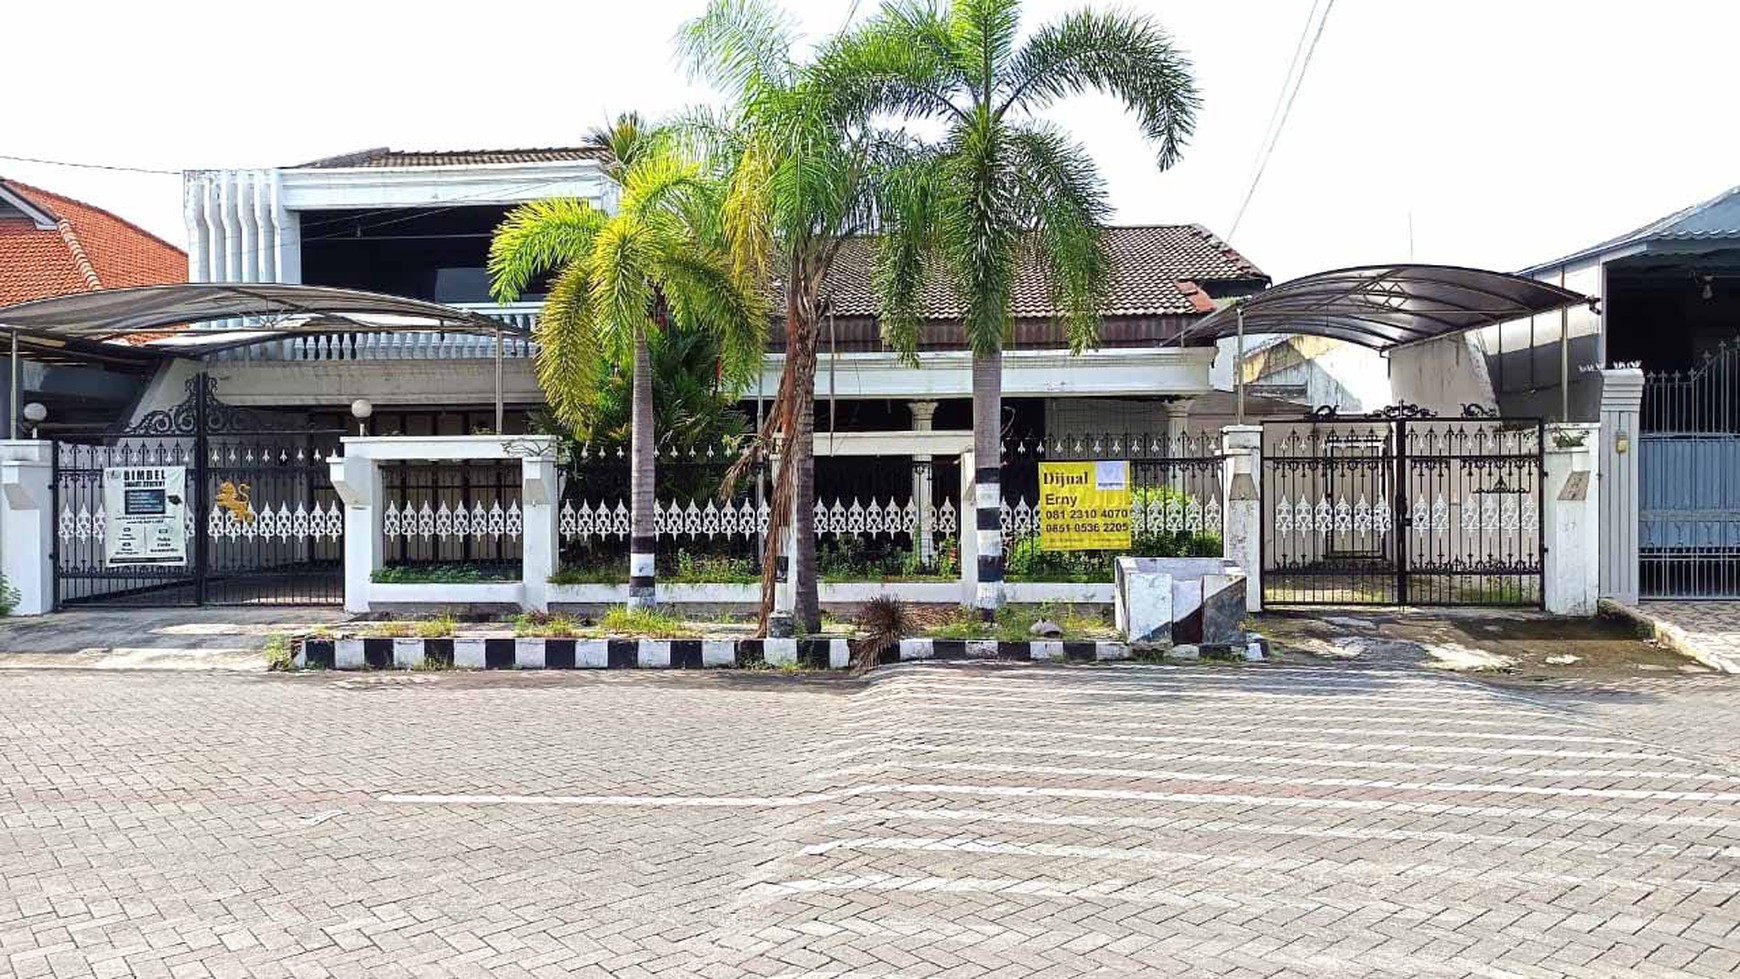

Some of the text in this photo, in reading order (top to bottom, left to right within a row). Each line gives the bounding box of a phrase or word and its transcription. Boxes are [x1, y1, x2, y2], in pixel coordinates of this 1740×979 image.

[124, 470, 165, 480] BIMBEL
[1043, 472, 1088, 488] Dijual
[1045, 493, 1077, 507] Erny
[1046, 508, 1128, 520] 081 2310 4070
[1046, 522, 1129, 533] 0851 0536 2205
